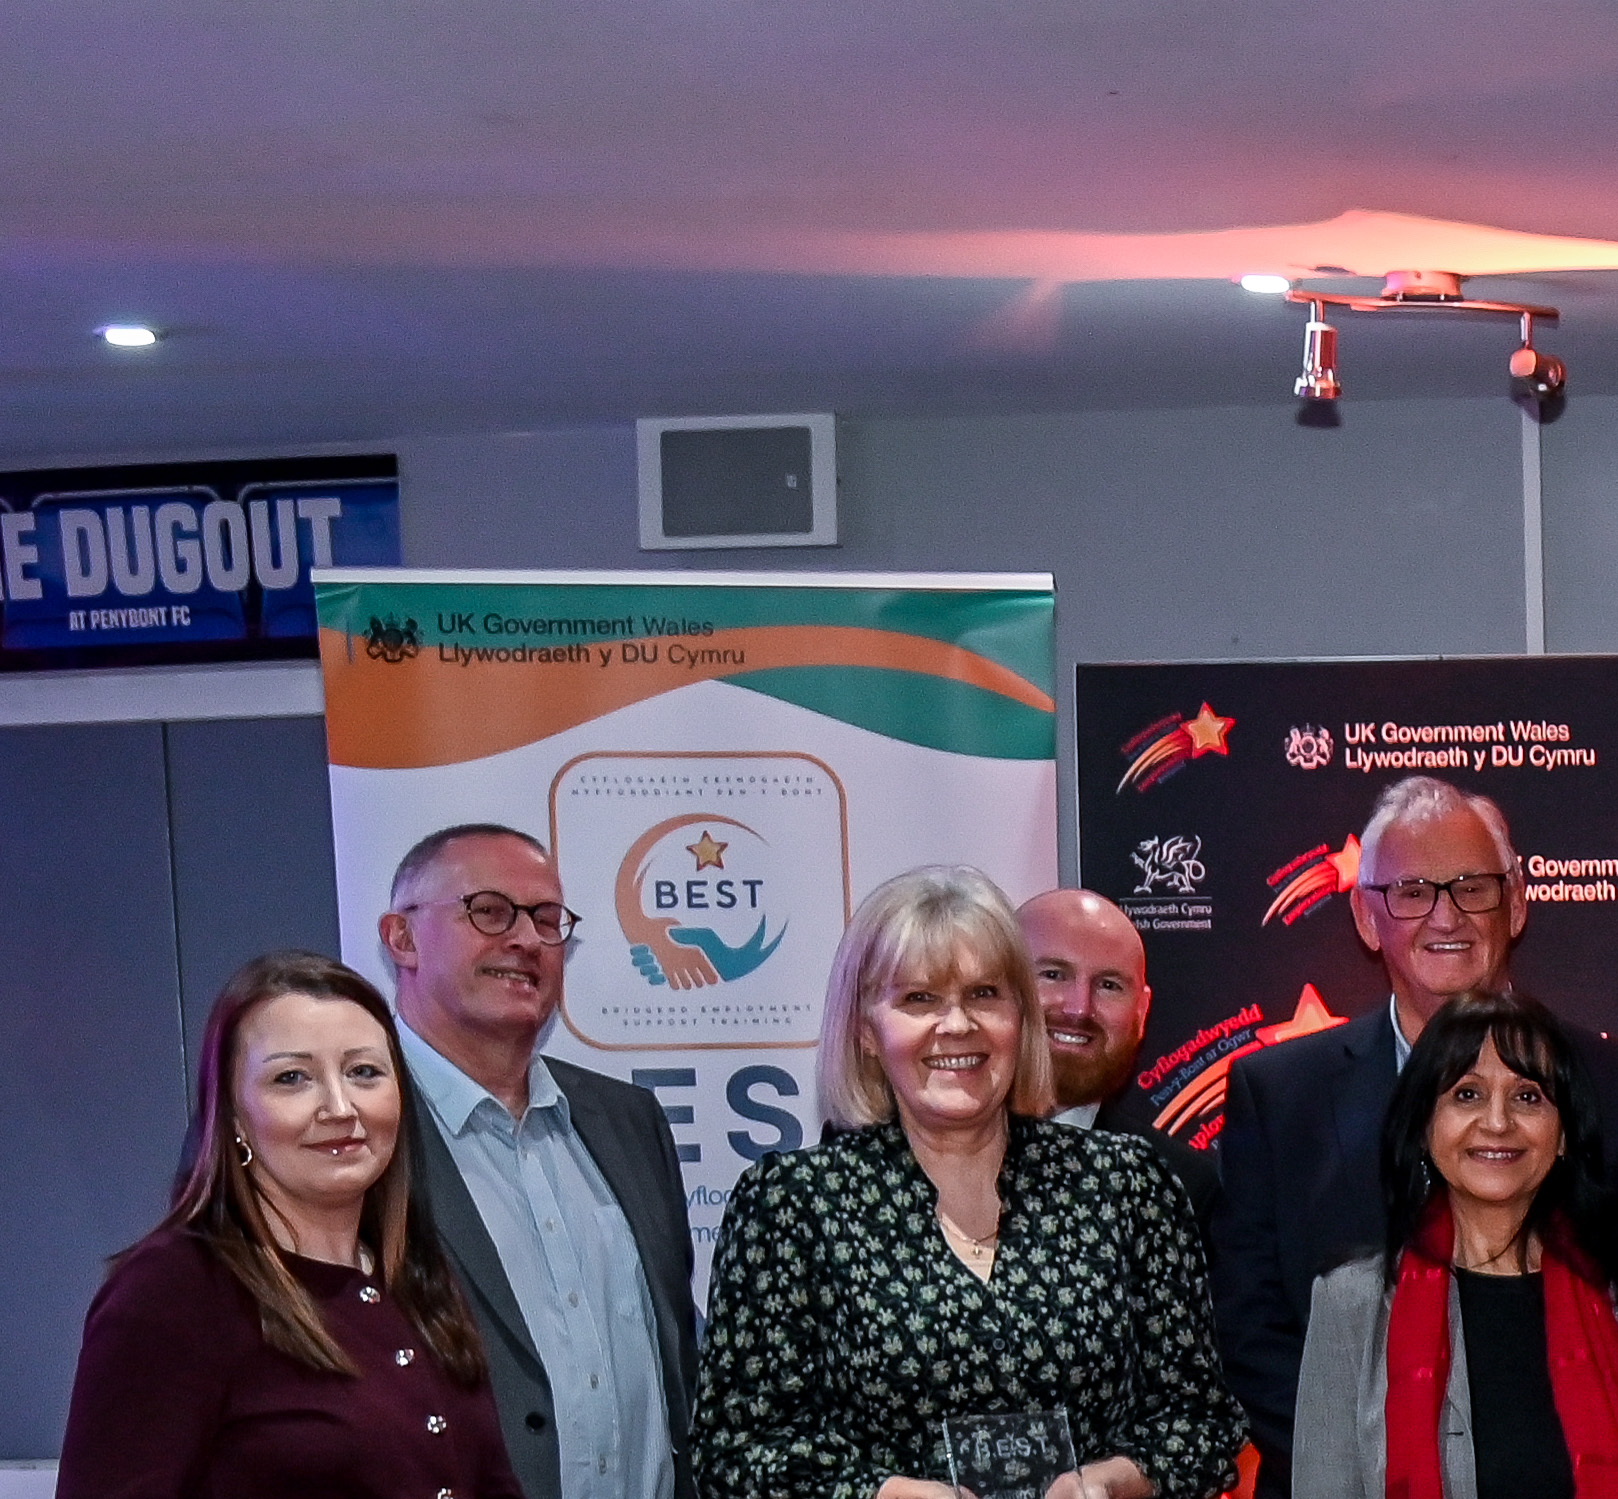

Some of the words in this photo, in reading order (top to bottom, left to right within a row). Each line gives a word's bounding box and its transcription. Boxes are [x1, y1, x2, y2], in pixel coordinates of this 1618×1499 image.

[60, 498, 342, 597] DUGOUT
[171, 606, 191, 627] FC
[438, 613, 476, 635] UK
[483, 613, 635, 636] Government
[643, 616, 715, 637] Wales
[438, 642, 591, 667] Llywodraeth
[600, 647, 612, 667] y
[622, 643, 659, 664] DU
[668, 644, 746, 668] Cymru
[1344, 722, 1376, 743] UK
[1381, 721, 1503, 744] Government
[1509, 720, 1570, 742] Wales
[1344, 746, 1469, 769] Llywodraeth
[1474, 750, 1485, 771] y
[1492, 746, 1523, 765] DU
[1529, 745, 1596, 770] Cymru
[655, 880, 764, 909] BEST
[1181, 903, 1213, 916] Cymru
[1153, 919, 1212, 930] Government
